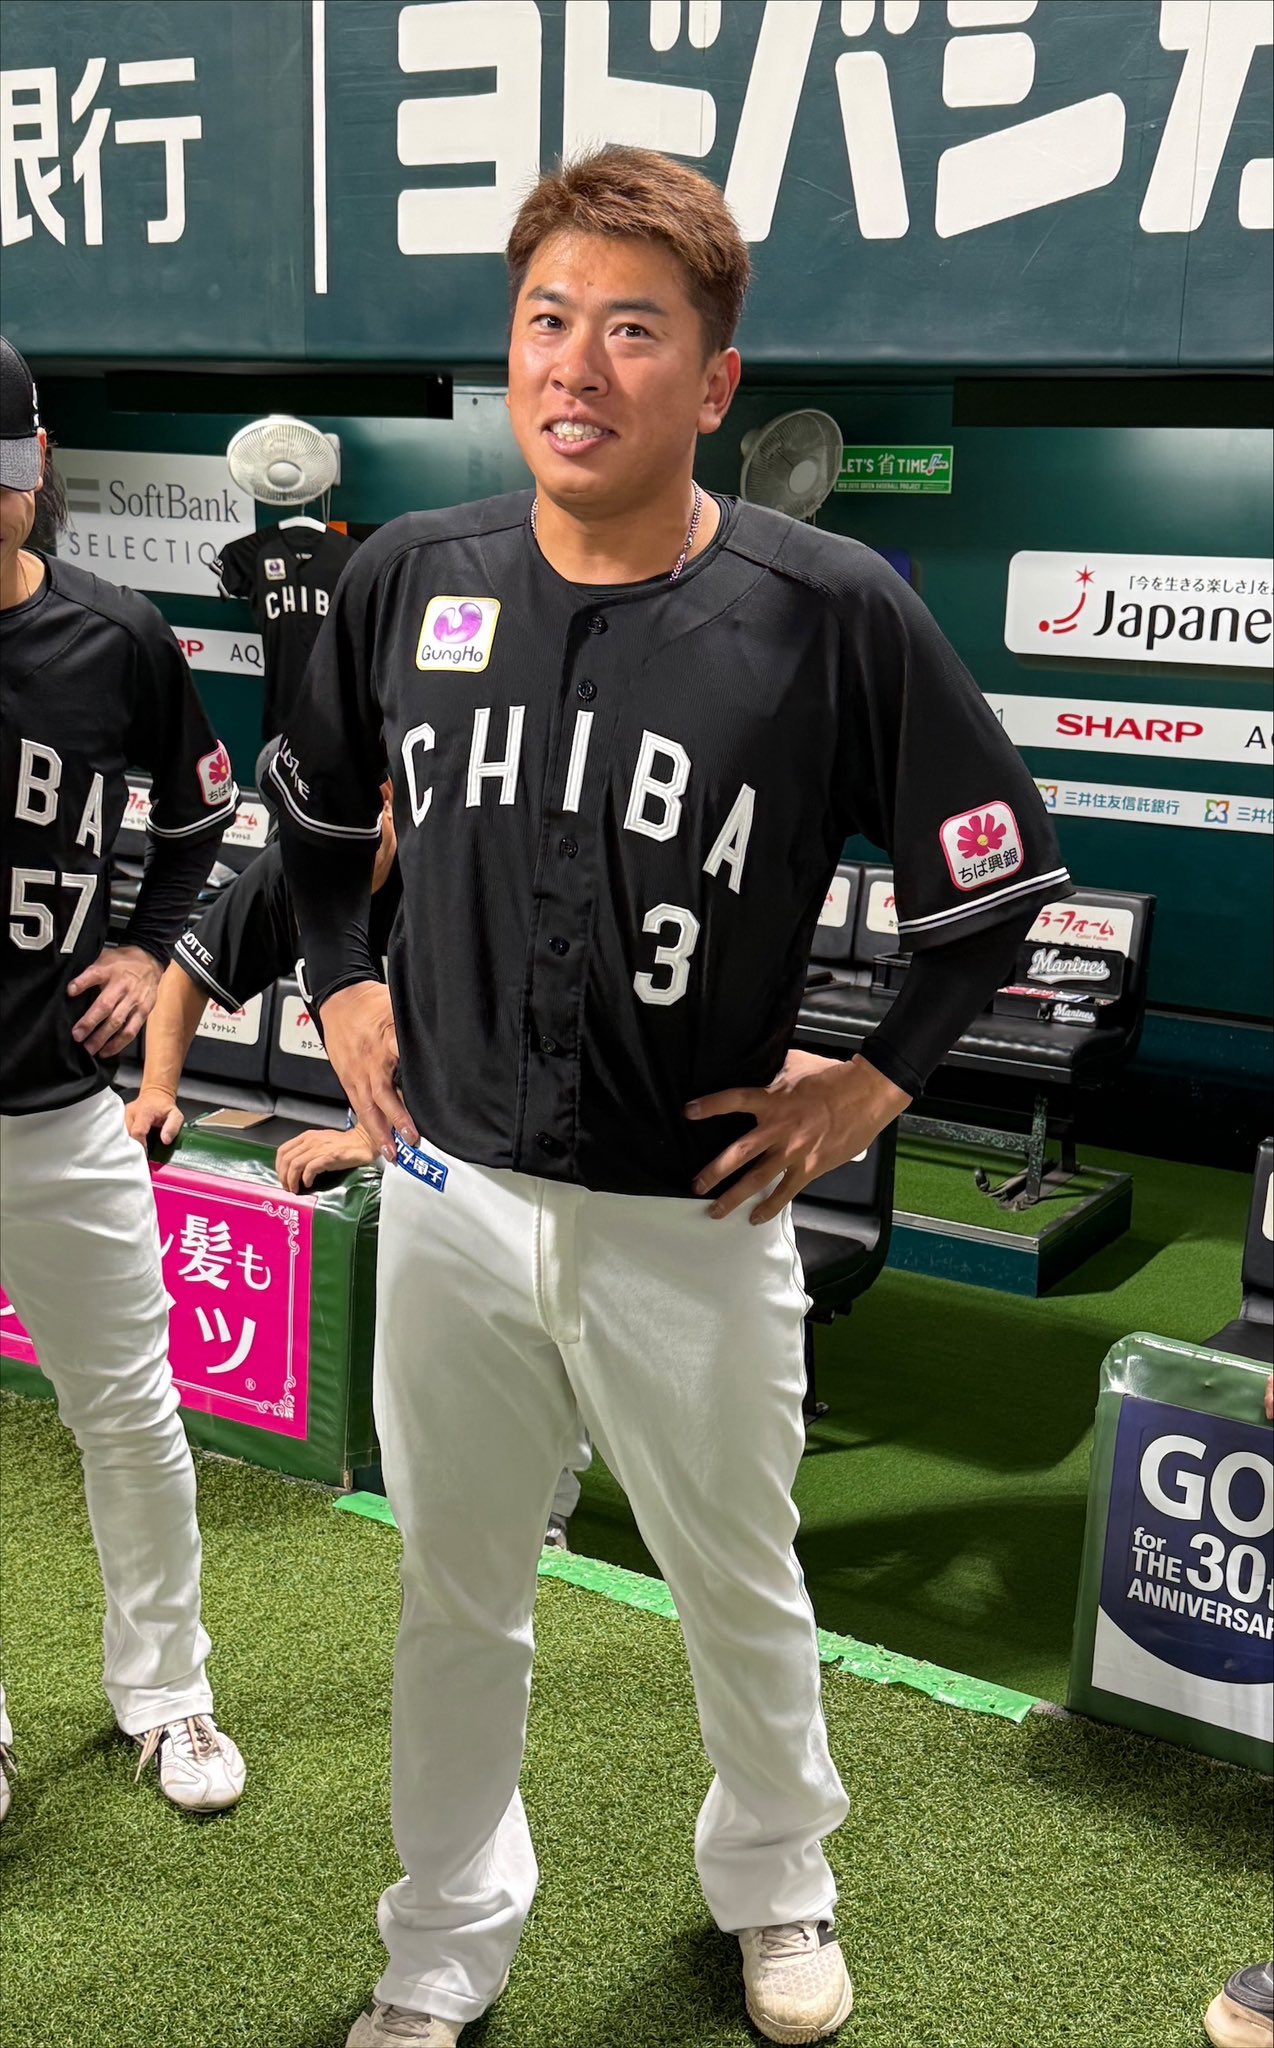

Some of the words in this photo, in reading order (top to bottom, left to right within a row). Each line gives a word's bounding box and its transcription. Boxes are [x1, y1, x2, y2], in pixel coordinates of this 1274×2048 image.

[897, 459, 928, 474] TIME
[109, 480, 241, 523] SoftBank
[265, 585, 330, 620] CHIB
[1129, 575, 1274, 596] 「今を生きる楽しさ」を
[1093, 590, 1273, 650] Japane
[230, 643, 264, 669] AQ
[421, 644, 484, 665] GungHo
[1056, 713, 1204, 743] SHARP
[1244, 725, 1274, 750] A
[14, 737, 104, 858] BA
[401, 705, 757, 895] CHIBA
[1064, 790, 1180, 816] 三井住友信託銀行
[958, 847, 1019, 885] ちば興銀
[8, 866, 98, 954] 57
[182, 930, 214, 966] LOTTE
[633, 903, 700, 1006] 3
[1027, 948, 1110, 982] Marines
[1140, 1434, 1274, 1538] GO
[1133, 1526, 1167, 1552] for
[1132, 1546, 1182, 1583] THE
